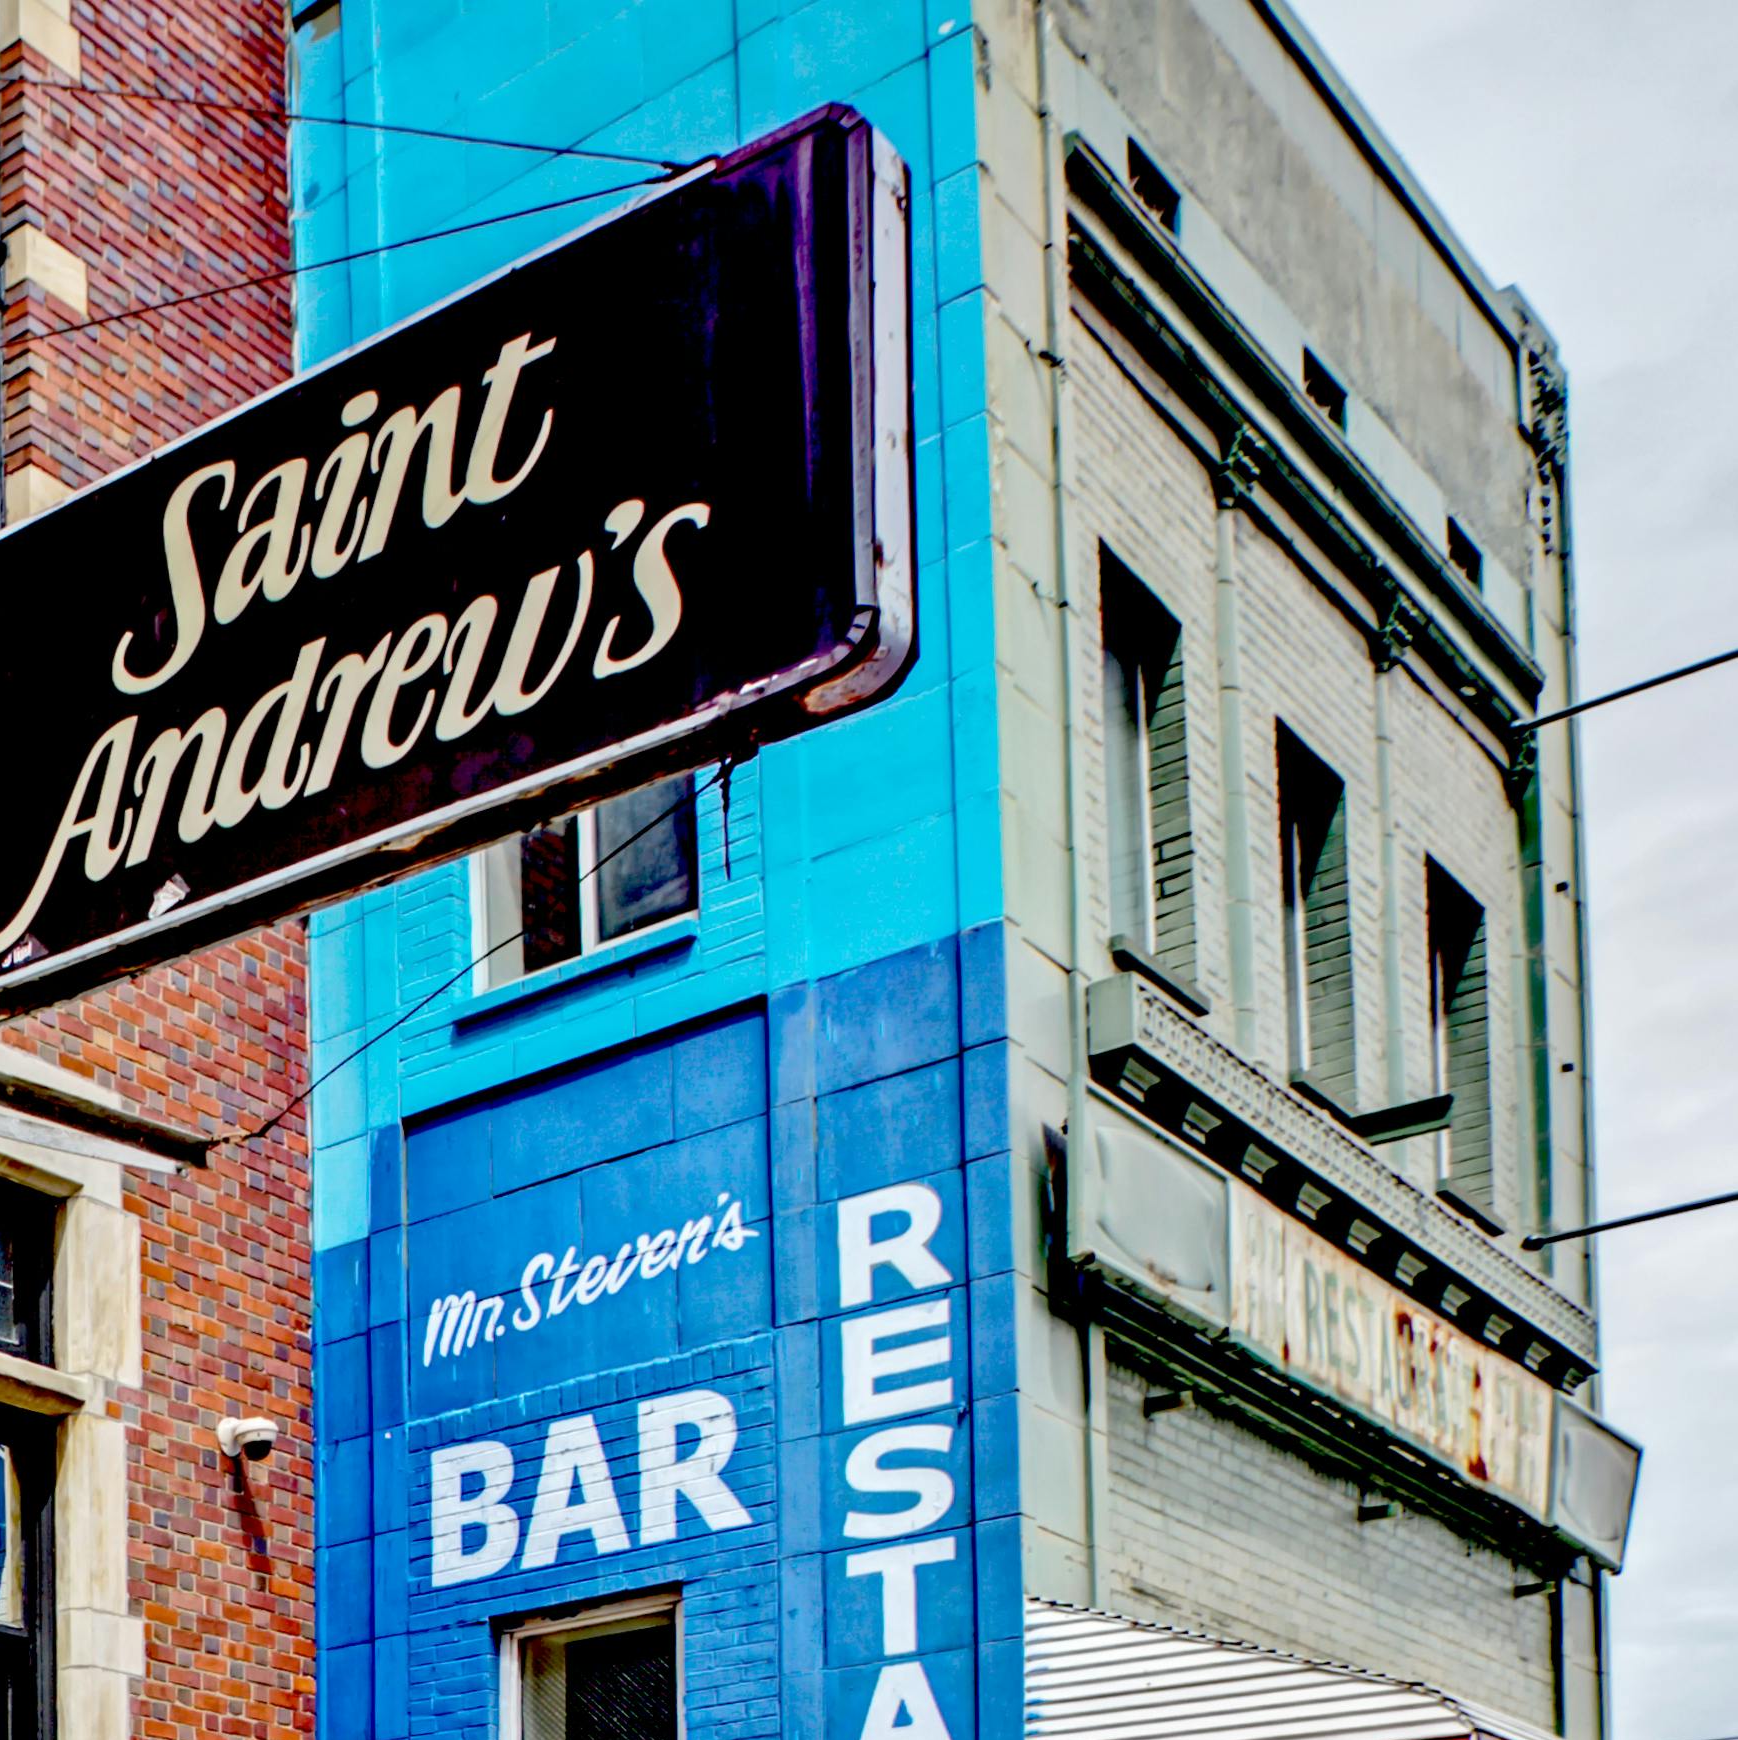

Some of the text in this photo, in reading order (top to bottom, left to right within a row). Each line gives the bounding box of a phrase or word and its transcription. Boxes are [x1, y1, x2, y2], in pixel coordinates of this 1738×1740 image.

[111, 331, 558, 696] Saint
[423, 1193, 760, 1367] Mr. Steven's
[431, 1389, 753, 1588] BAR
